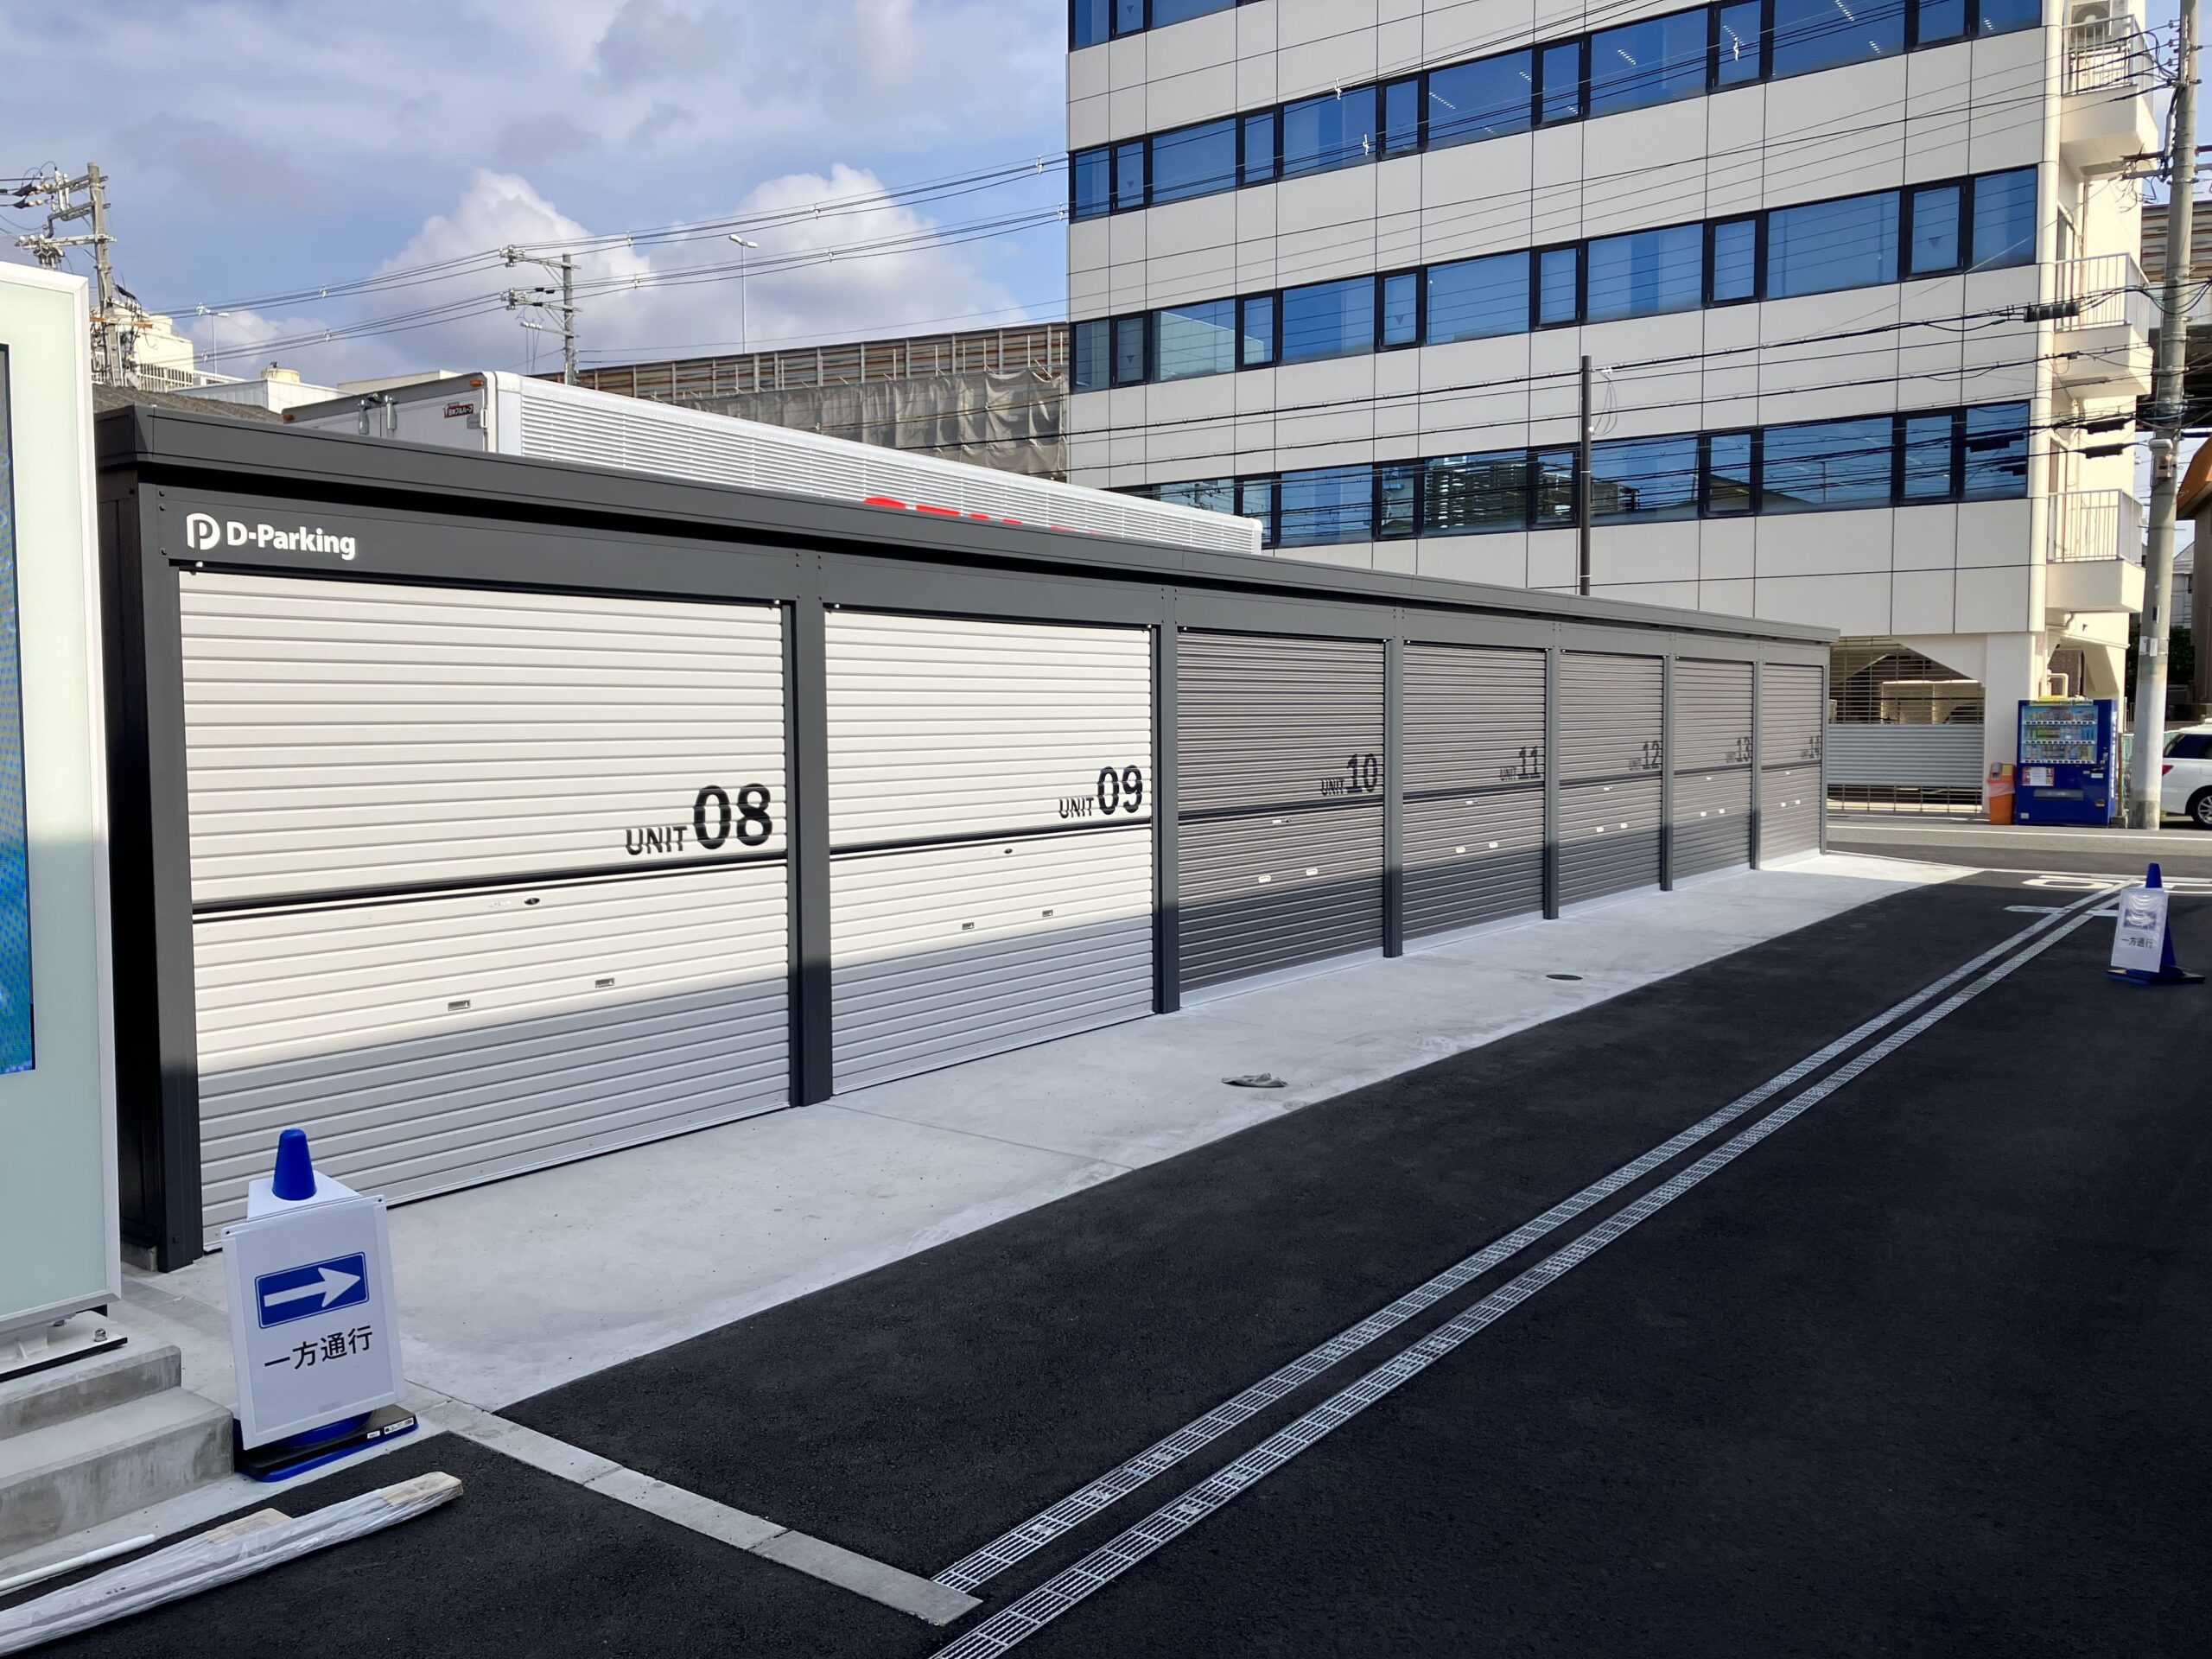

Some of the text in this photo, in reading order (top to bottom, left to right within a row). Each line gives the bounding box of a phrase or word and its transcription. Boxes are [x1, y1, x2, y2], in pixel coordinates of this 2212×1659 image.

[226, 521, 356, 560] D-Parking
[1519, 746, 1541, 779] 11
[1643, 741, 1659, 769] 12
[1736, 737, 1751, 762] 13
[1059, 765, 1142, 818] UNIT 09
[1321, 753, 1377, 796] UNIT 10
[626, 783, 772, 855] UNIT 08
[264, 1325, 373, 1370] 一方通行
